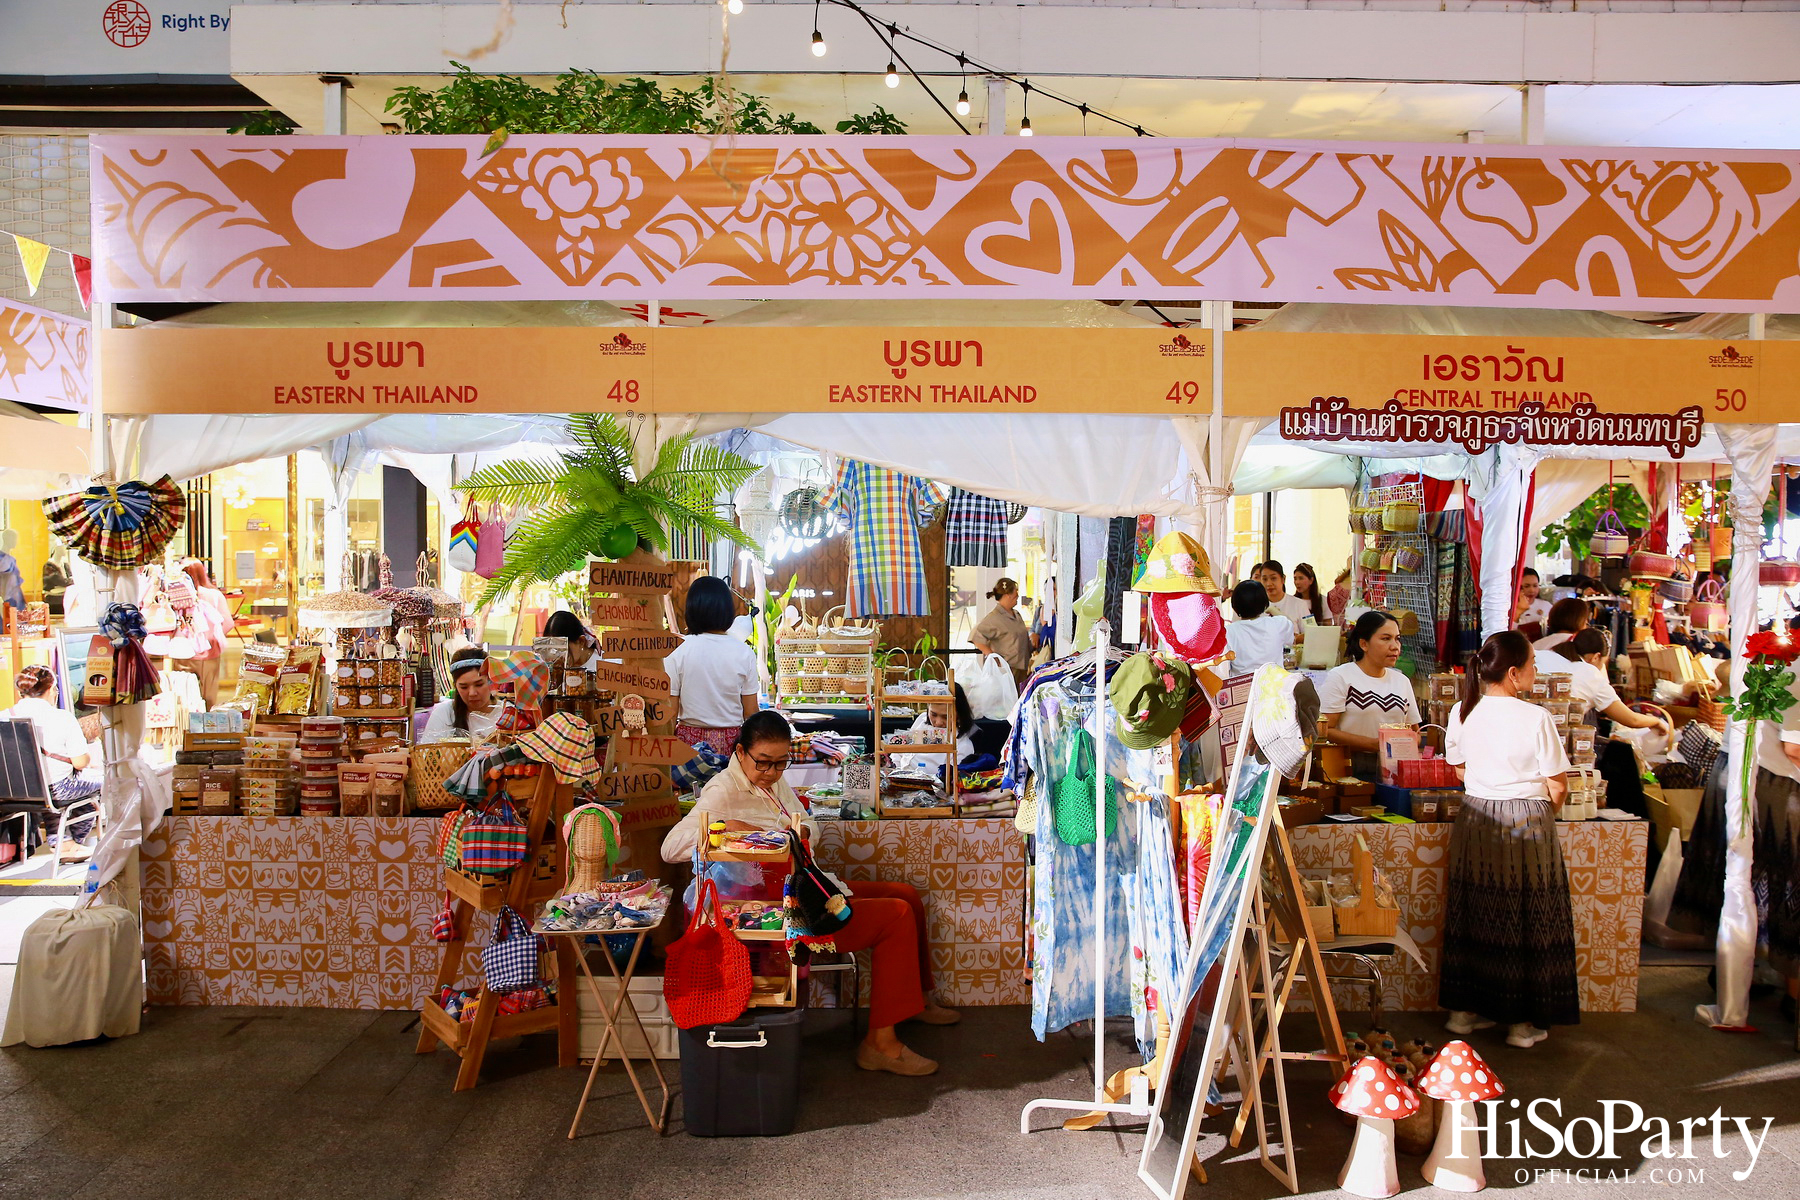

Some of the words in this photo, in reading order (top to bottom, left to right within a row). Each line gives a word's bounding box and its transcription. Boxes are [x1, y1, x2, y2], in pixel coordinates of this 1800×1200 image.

[162, 14, 205, 32] Right
[210, 14, 230, 31] By
[327, 341, 424, 381] บูรพา
[884, 340, 982, 380] บูรพา
[1423, 345, 1564, 383] เอราวัณ
[275, 386, 365, 404] EASTERN
[373, 386, 478, 404] THAILAND
[607, 380, 640, 403] 48
[829, 385, 921, 403] EASTERN
[930, 385, 1037, 403] THAILAND
[1165, 381, 1199, 404] 49
[1394, 389, 1483, 408] CENTRAL
[1491, 391, 1593, 409] THAILAND
[1714, 388, 1747, 412] 50
[1284, 401, 1700, 454] แม่บ้านตำรวจภูธรจังหวัดนนทบุรี
[590, 567, 674, 588] CHANTHABURI
[597, 604, 648, 621] CHONBURI
[606, 636, 679, 652] PRACHINBURI
[597, 668, 669, 691] CHACHOENGSAO
[600, 702, 664, 733] RANG
[625, 737, 678, 758] TRAT
[604, 773, 662, 796] SAKAEO
[642, 804, 679, 822] NAYOK
